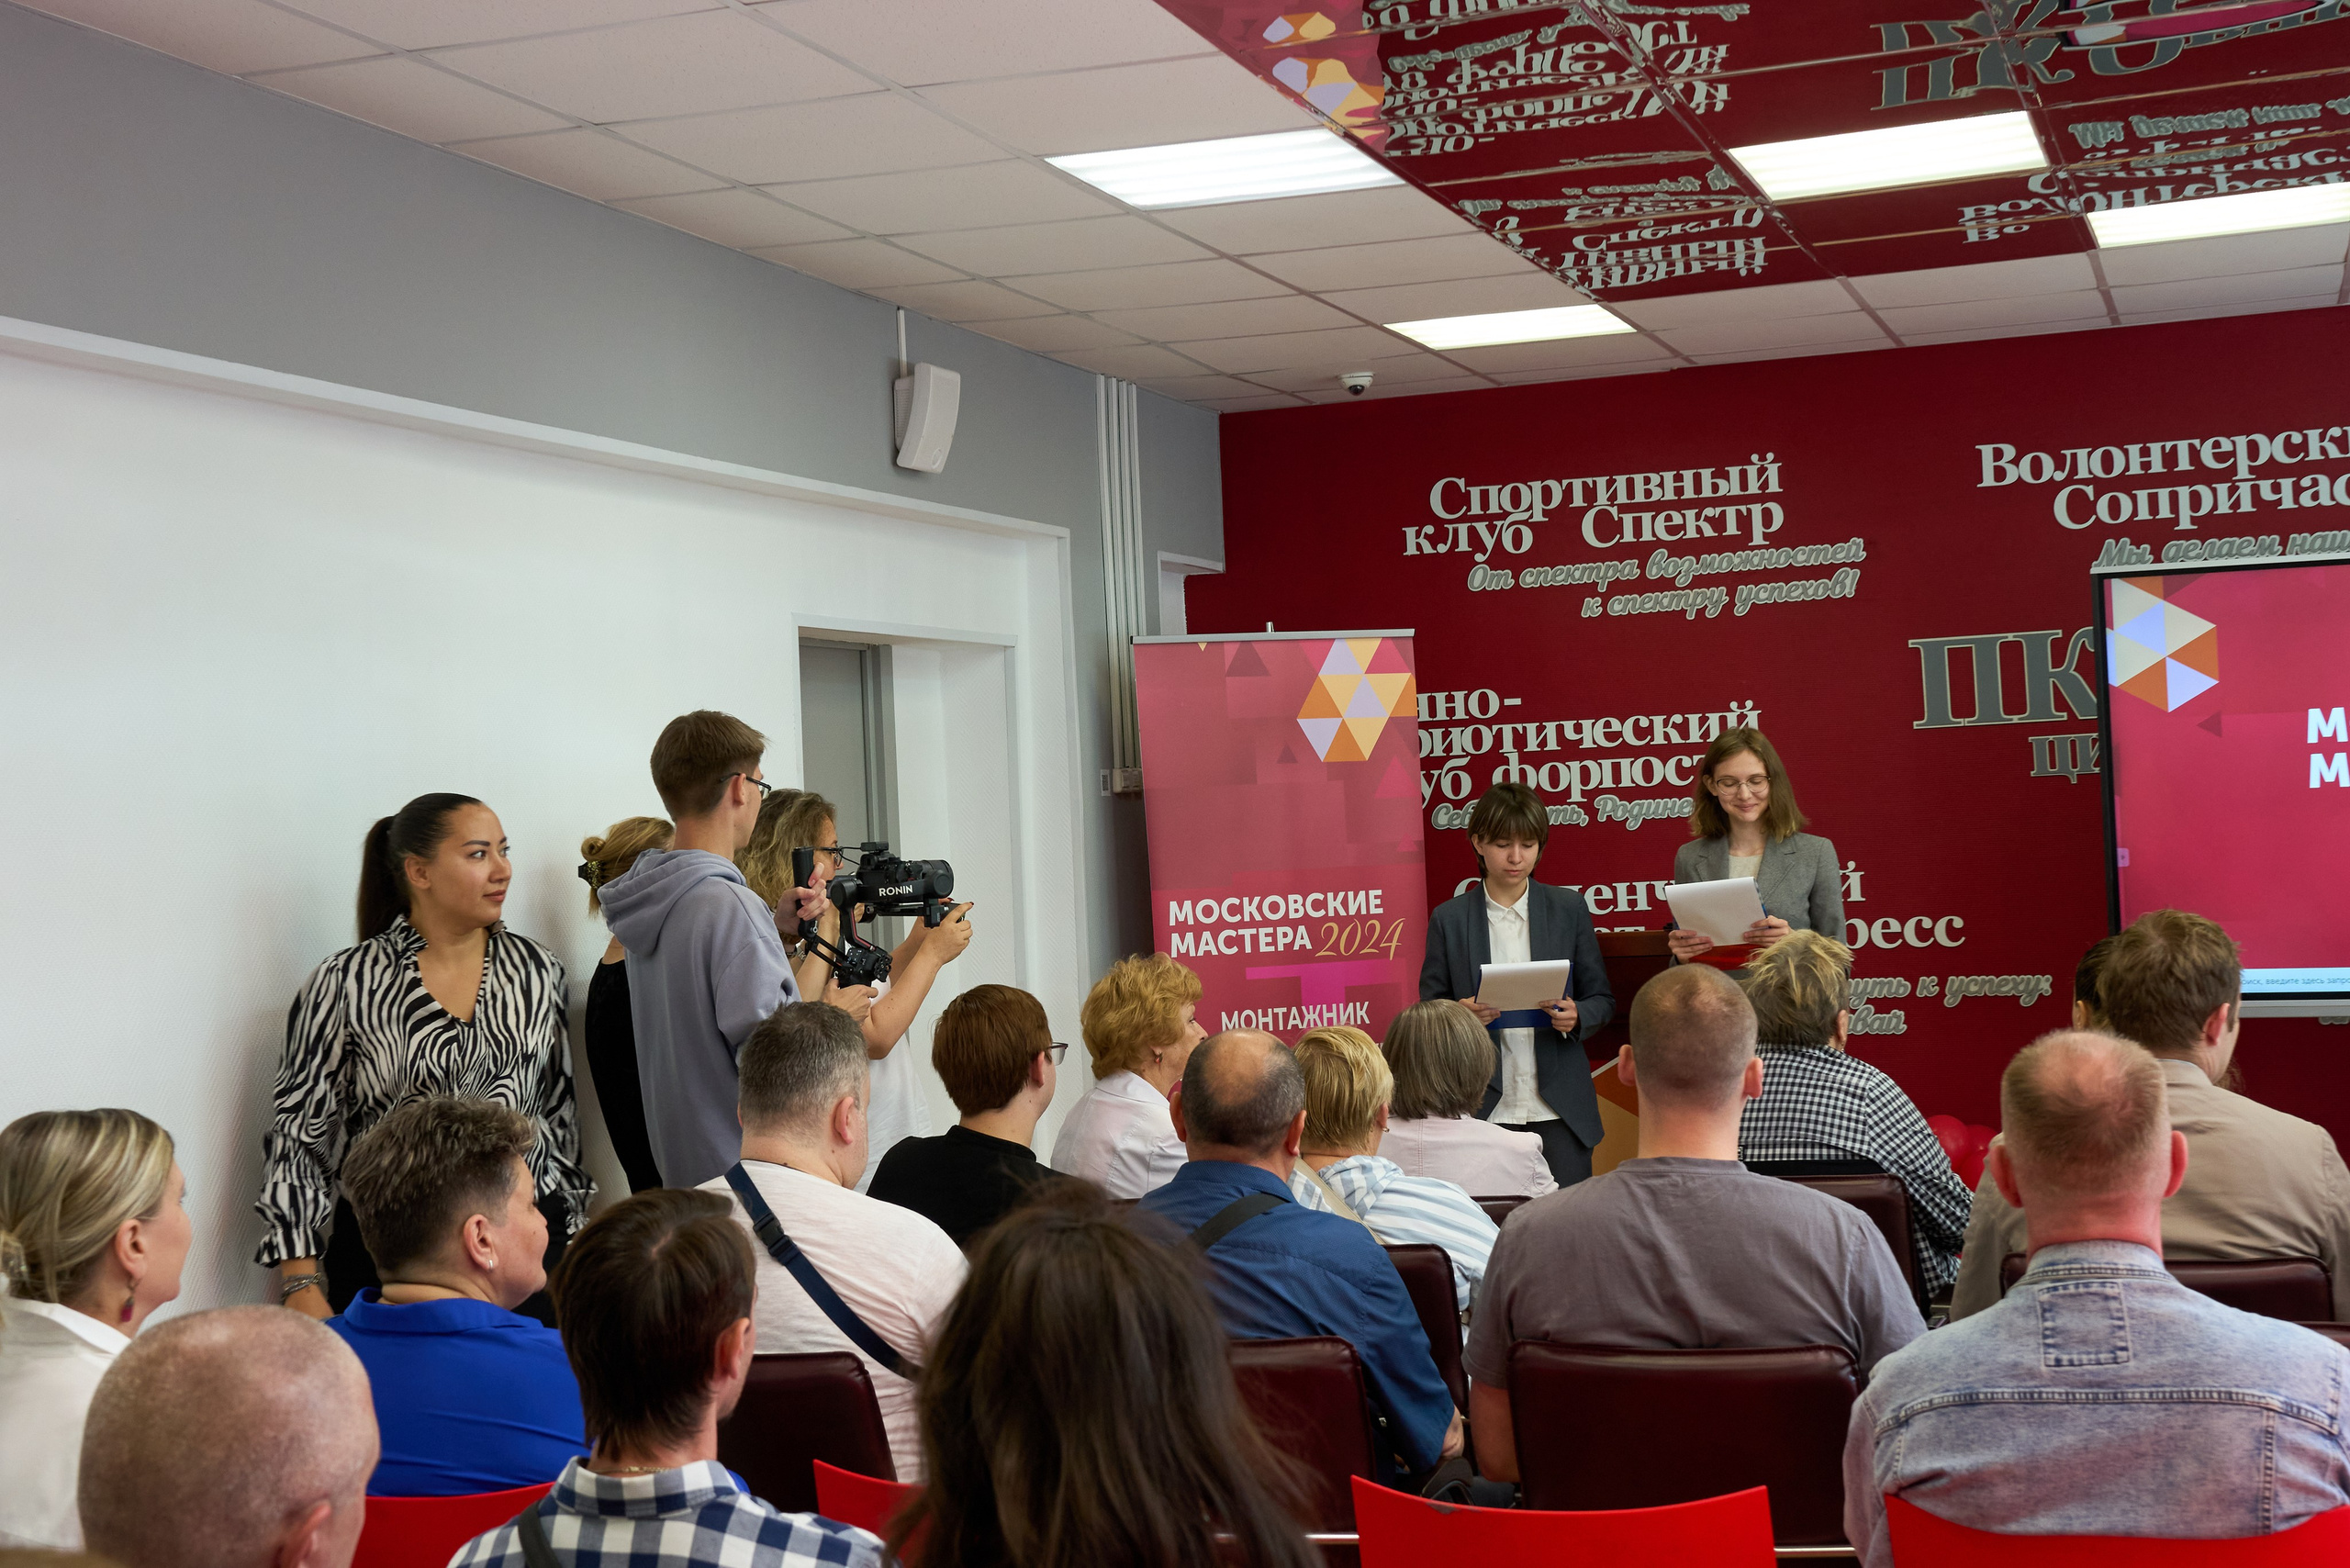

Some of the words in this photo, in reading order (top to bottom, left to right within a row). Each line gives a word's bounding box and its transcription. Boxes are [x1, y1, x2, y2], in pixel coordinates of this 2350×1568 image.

[1428, 452, 1784, 522] Спортивный
[1402, 511, 1533, 562] клуб
[1581, 500, 1785, 547] Спектр
[1468, 564, 1514, 590] От
[1519, 557, 1639, 590] спектра
[1645, 537, 1866, 586] возможностей
[1581, 597, 1602, 618] к
[1607, 584, 1729, 620] спектру
[1733, 569, 1861, 615] успехов!
[1908, 627, 2098, 729] ПК
[1420, 756, 1472, 809] уб
[1492, 752, 1706, 802] форпос
[878, 884, 913, 897] RONIN
[1169, 890, 1383, 926] МОСКОВСКИЕ
[1170, 925, 1313, 958] МАСТЕРА
[1315, 918, 1406, 961] 2024
[1221, 1001, 1371, 1032] МОНТАЖНИК
[1916, 976, 1940, 998] к
[1943, 975, 2053, 1007] успеху:
